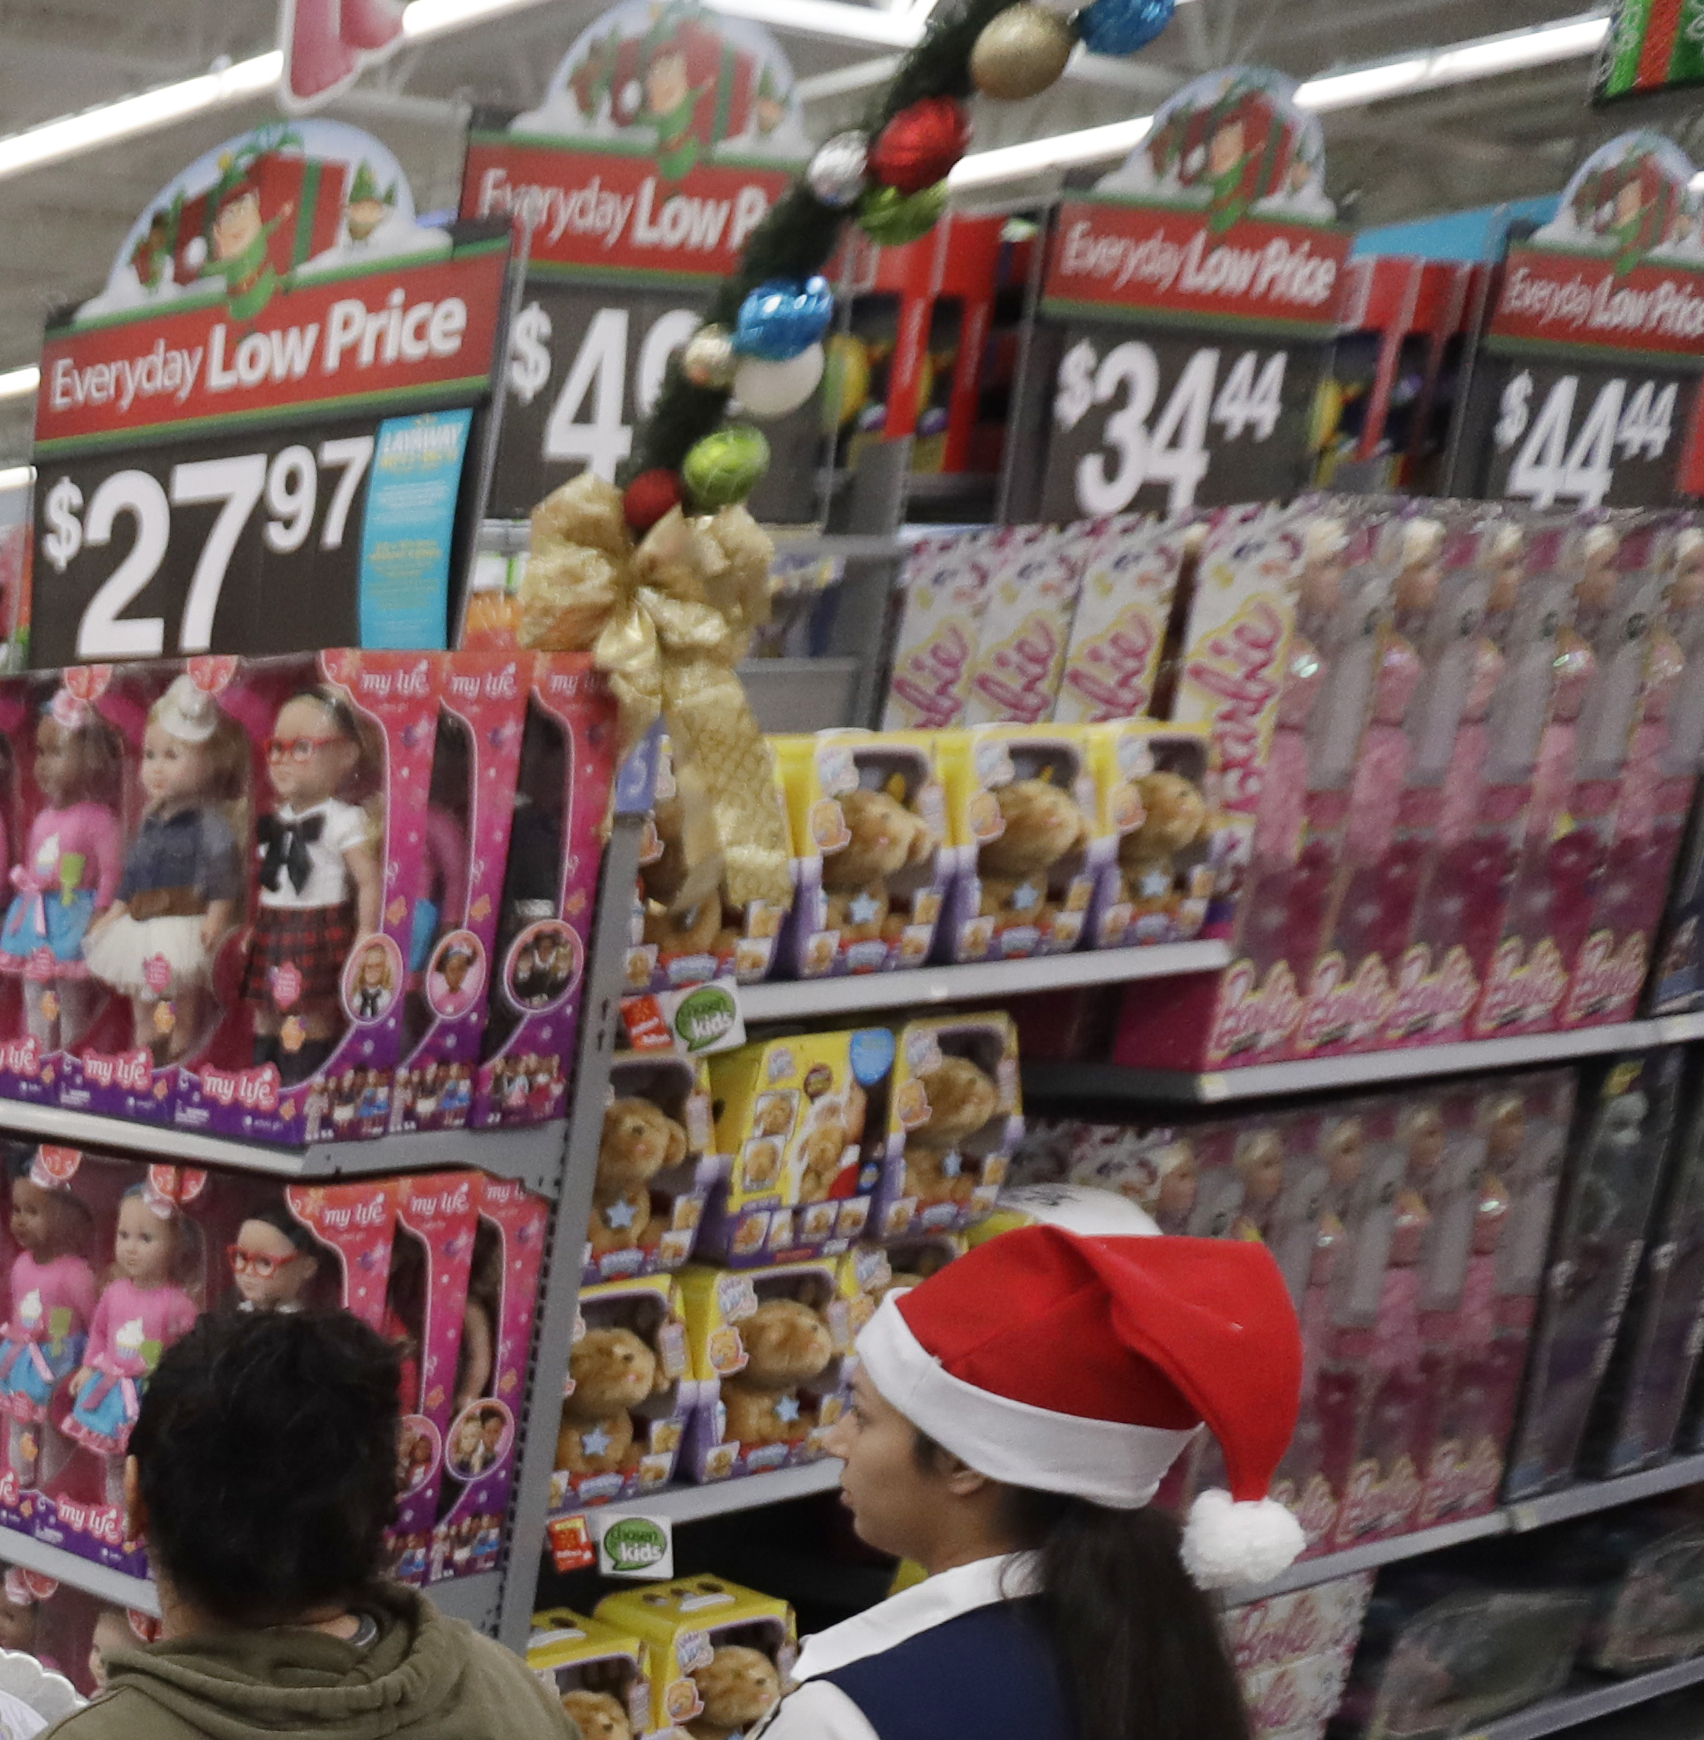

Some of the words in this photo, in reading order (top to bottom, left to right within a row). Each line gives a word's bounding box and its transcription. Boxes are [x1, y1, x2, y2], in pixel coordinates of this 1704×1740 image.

[481, 169, 631, 255] Everyday
[636, 176, 727, 250] Low
[1061, 220, 1188, 288] Everyday
[1189, 231, 1253, 294] Low
[1254, 231, 1337, 306] Price
[1505, 264, 1590, 328] Everyday
[1592, 273, 1650, 330] Low
[50, 340, 202, 411] Everyday
[206, 320, 319, 389] Low
[325, 290, 466, 368] Price
[361, 672, 391, 694] my
[397, 668, 424, 695] life
[9, 1044, 35, 1072] life
[86, 1057, 113, 1084] my
[117, 1058, 145, 1086] life
[204, 1076, 235, 1099] my
[240, 1078, 272, 1105] life
[324, 1206, 351, 1227] my
[355, 1204, 383, 1224] life
[59, 1502, 86, 1525] my
[88, 1507, 116, 1535] life
[620, 1542, 662, 1561] kids
